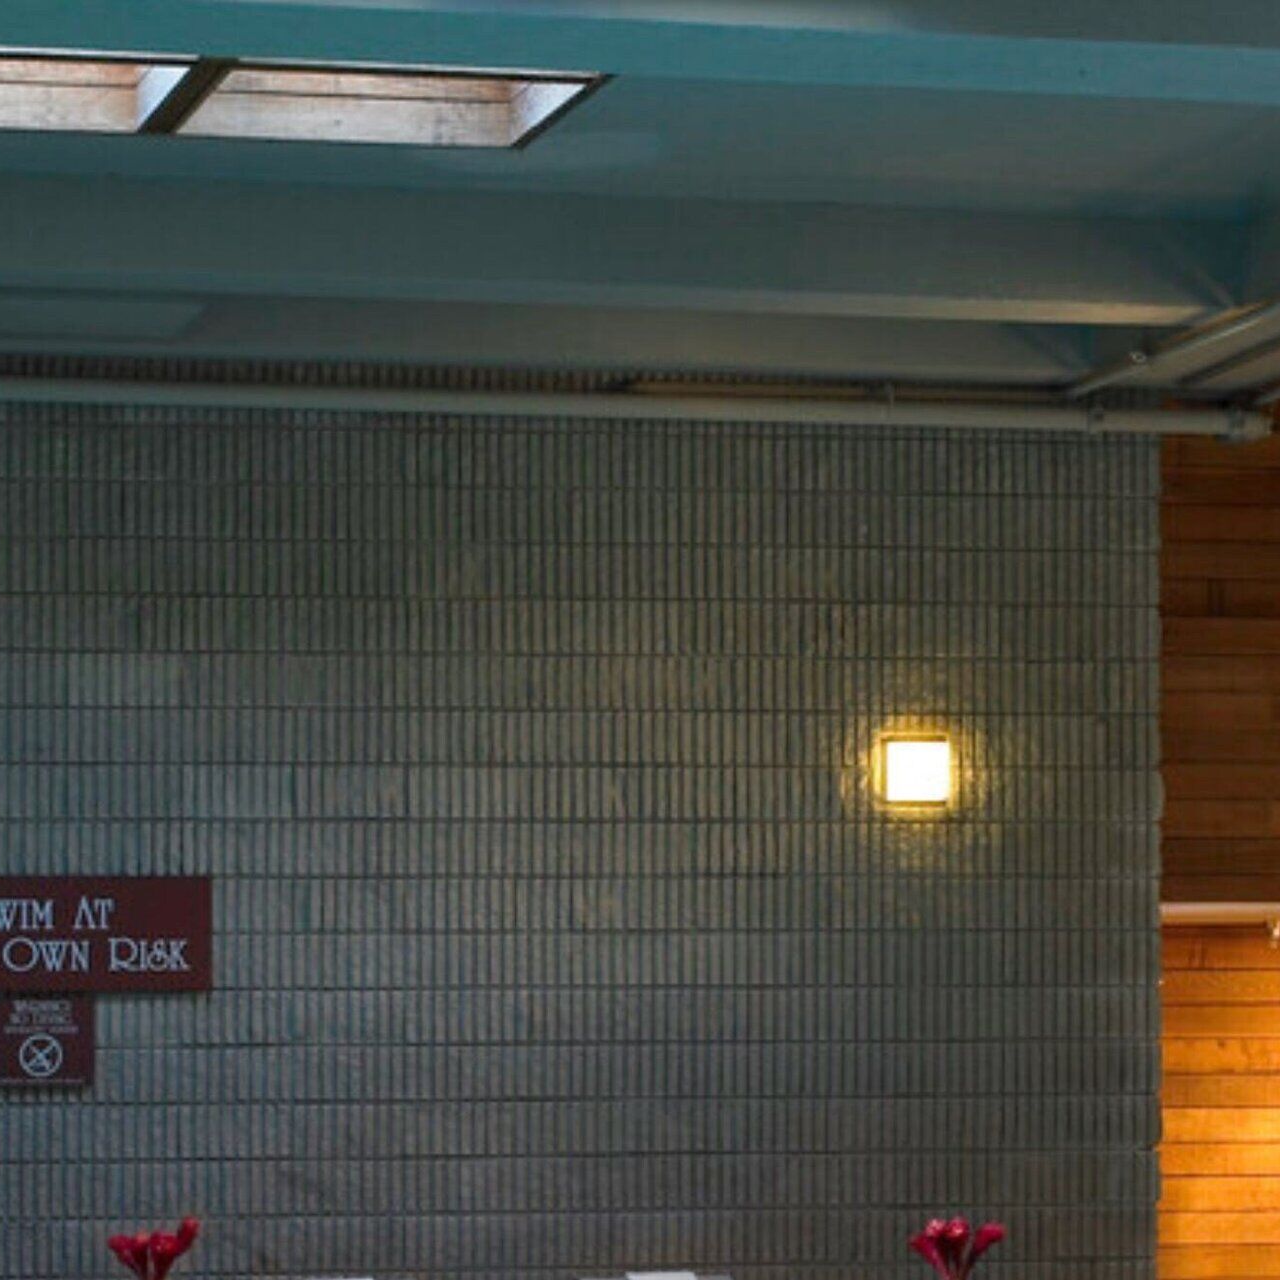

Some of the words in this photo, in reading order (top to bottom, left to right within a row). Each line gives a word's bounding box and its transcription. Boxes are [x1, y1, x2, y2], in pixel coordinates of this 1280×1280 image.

[73, 897, 115, 930] AT
[2, 936, 90, 973] OWN
[108, 937, 190, 972] RISK
